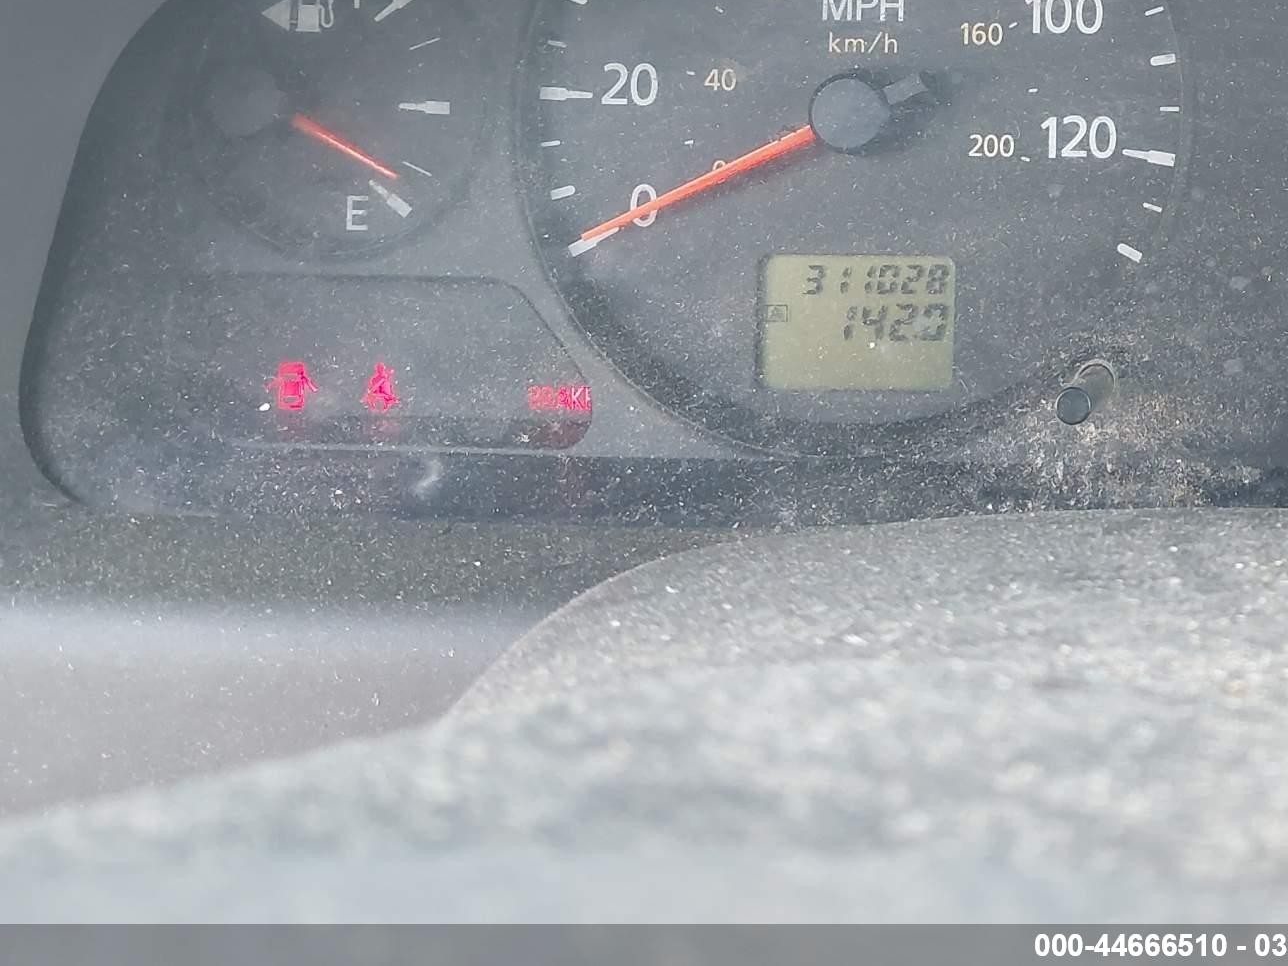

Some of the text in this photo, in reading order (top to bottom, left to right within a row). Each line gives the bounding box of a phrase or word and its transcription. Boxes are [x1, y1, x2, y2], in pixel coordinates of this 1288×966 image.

[828, 31, 898, 54] km/h
[960, 22, 1003, 46] 160
[601, 62, 659, 106] 20
[703, 68, 737, 91] 40
[968, 134, 1015, 158] 200
[1040, 115, 1117, 159] 120
[346, 195, 369, 231] E
[630, 183, 657, 227] 0
[803, 265, 949, 294] 311028
